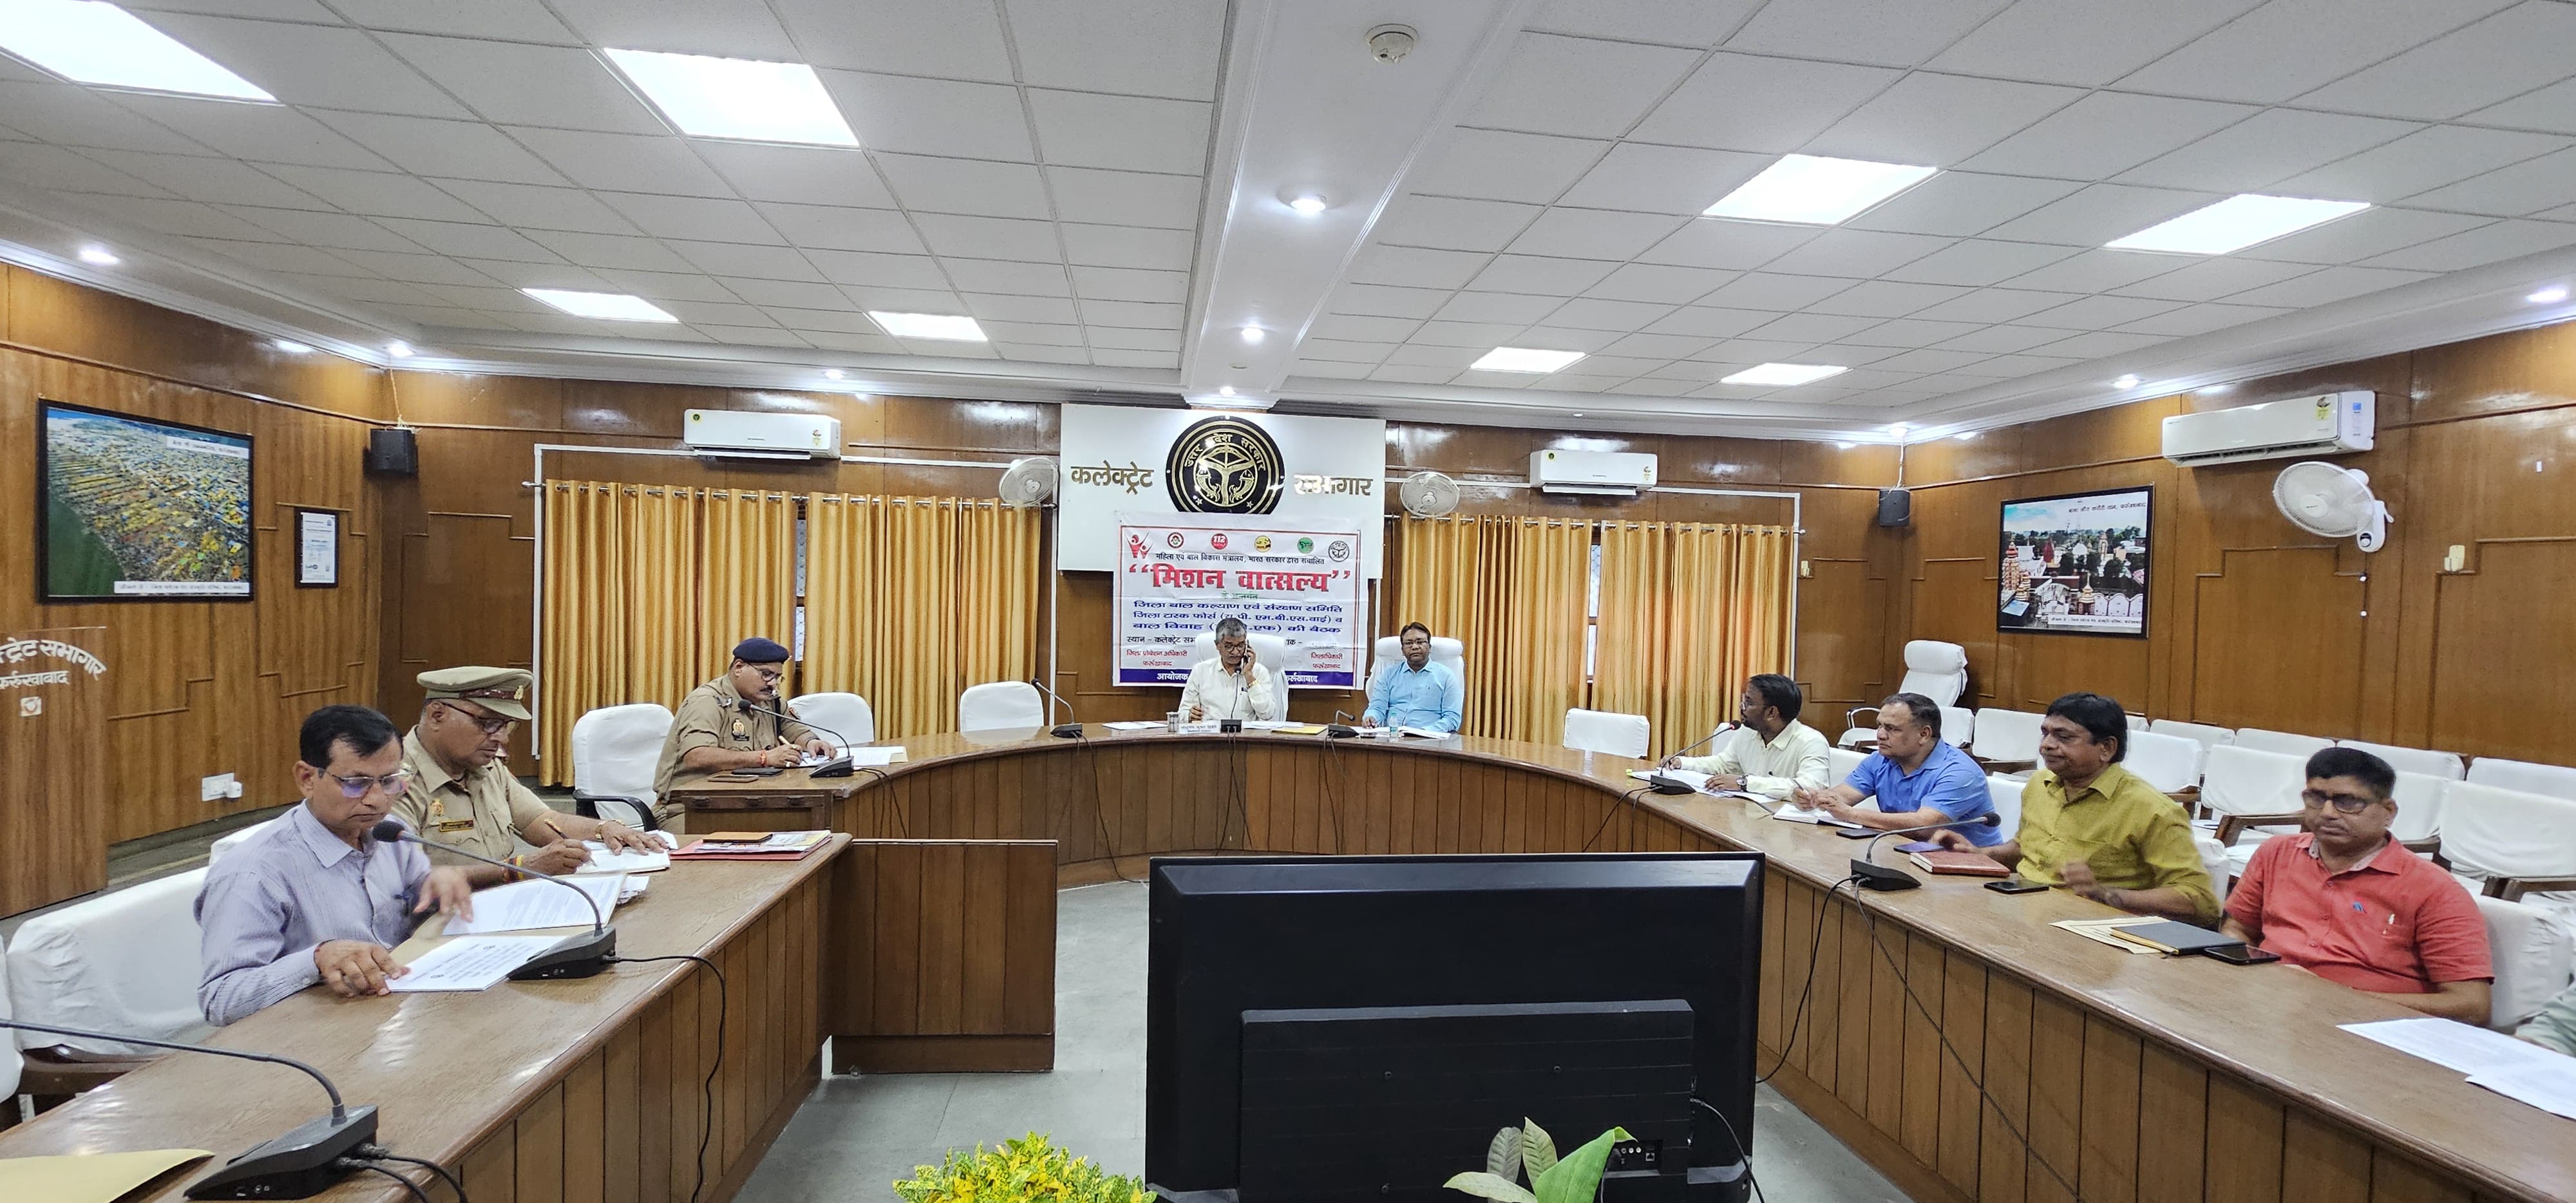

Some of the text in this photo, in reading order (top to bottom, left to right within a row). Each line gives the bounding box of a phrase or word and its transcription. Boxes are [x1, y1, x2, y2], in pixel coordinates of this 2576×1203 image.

[1241, 437, 1266, 471] सरकार
[1070, 459, 1154, 495] कलेक्ट्रेट
[1155, 552, 1173, 560] महिला
[1201, 552, 1220, 561] विकास
[1164, 621, 1204, 630] विवाह
[1309, 625, 1343, 633] बैठक
[1154, 634, 1182, 645] कलेक्ट्रेट
[40, 639, 107, 681] सभागार
[1157, 671, 1188, 681] आयोजक
